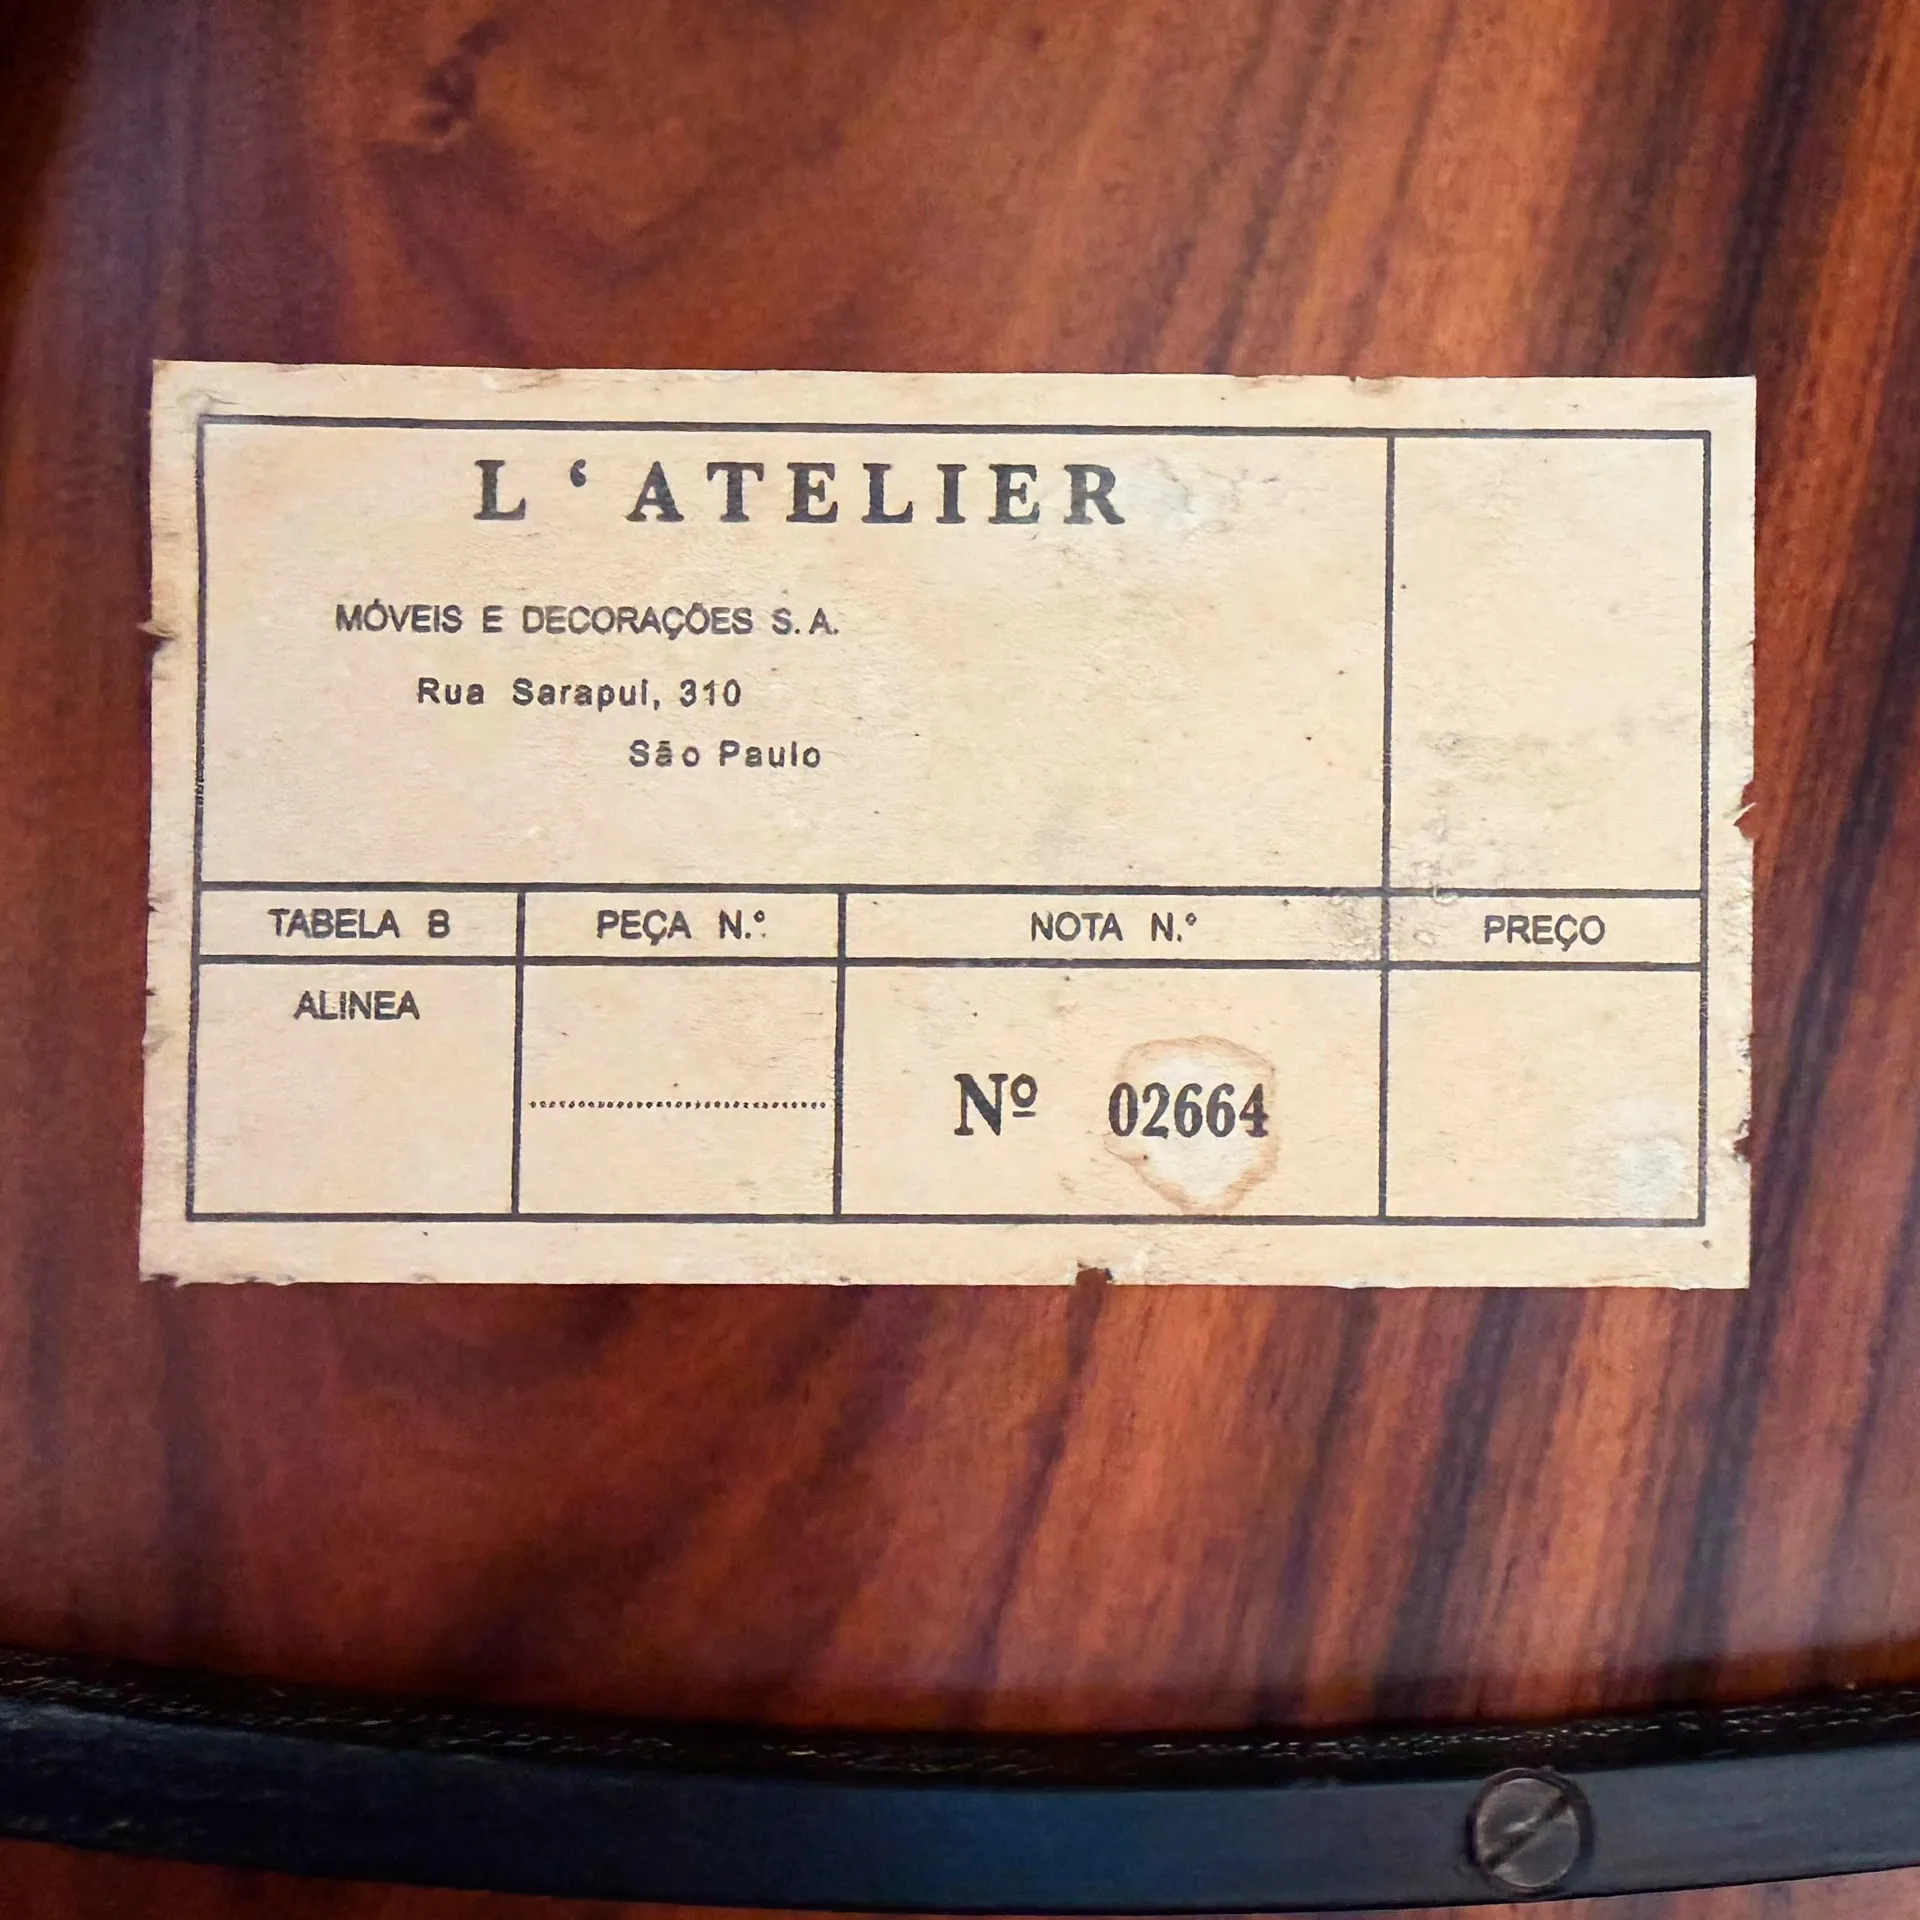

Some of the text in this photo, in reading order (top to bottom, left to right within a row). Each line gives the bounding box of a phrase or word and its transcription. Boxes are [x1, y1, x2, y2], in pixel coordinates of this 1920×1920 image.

[335, 599, 463, 634] MÓVEIS
[482, 605, 503, 634] E
[522, 602, 753, 640] DECORAÇÕES
[417, 677, 485, 706] Rua
[679, 678, 742, 708] 310
[629, 739, 821, 769] São Paulo
[267, 907, 450, 939] TABELA B
[596, 909, 692, 946] PEÇA
[1031, 911, 1124, 942] NOTA
[1484, 914, 1605, 952] PREÇO
[292, 989, 421, 1021] ALINEA
[1108, 1082, 1269, 1139] 02664
